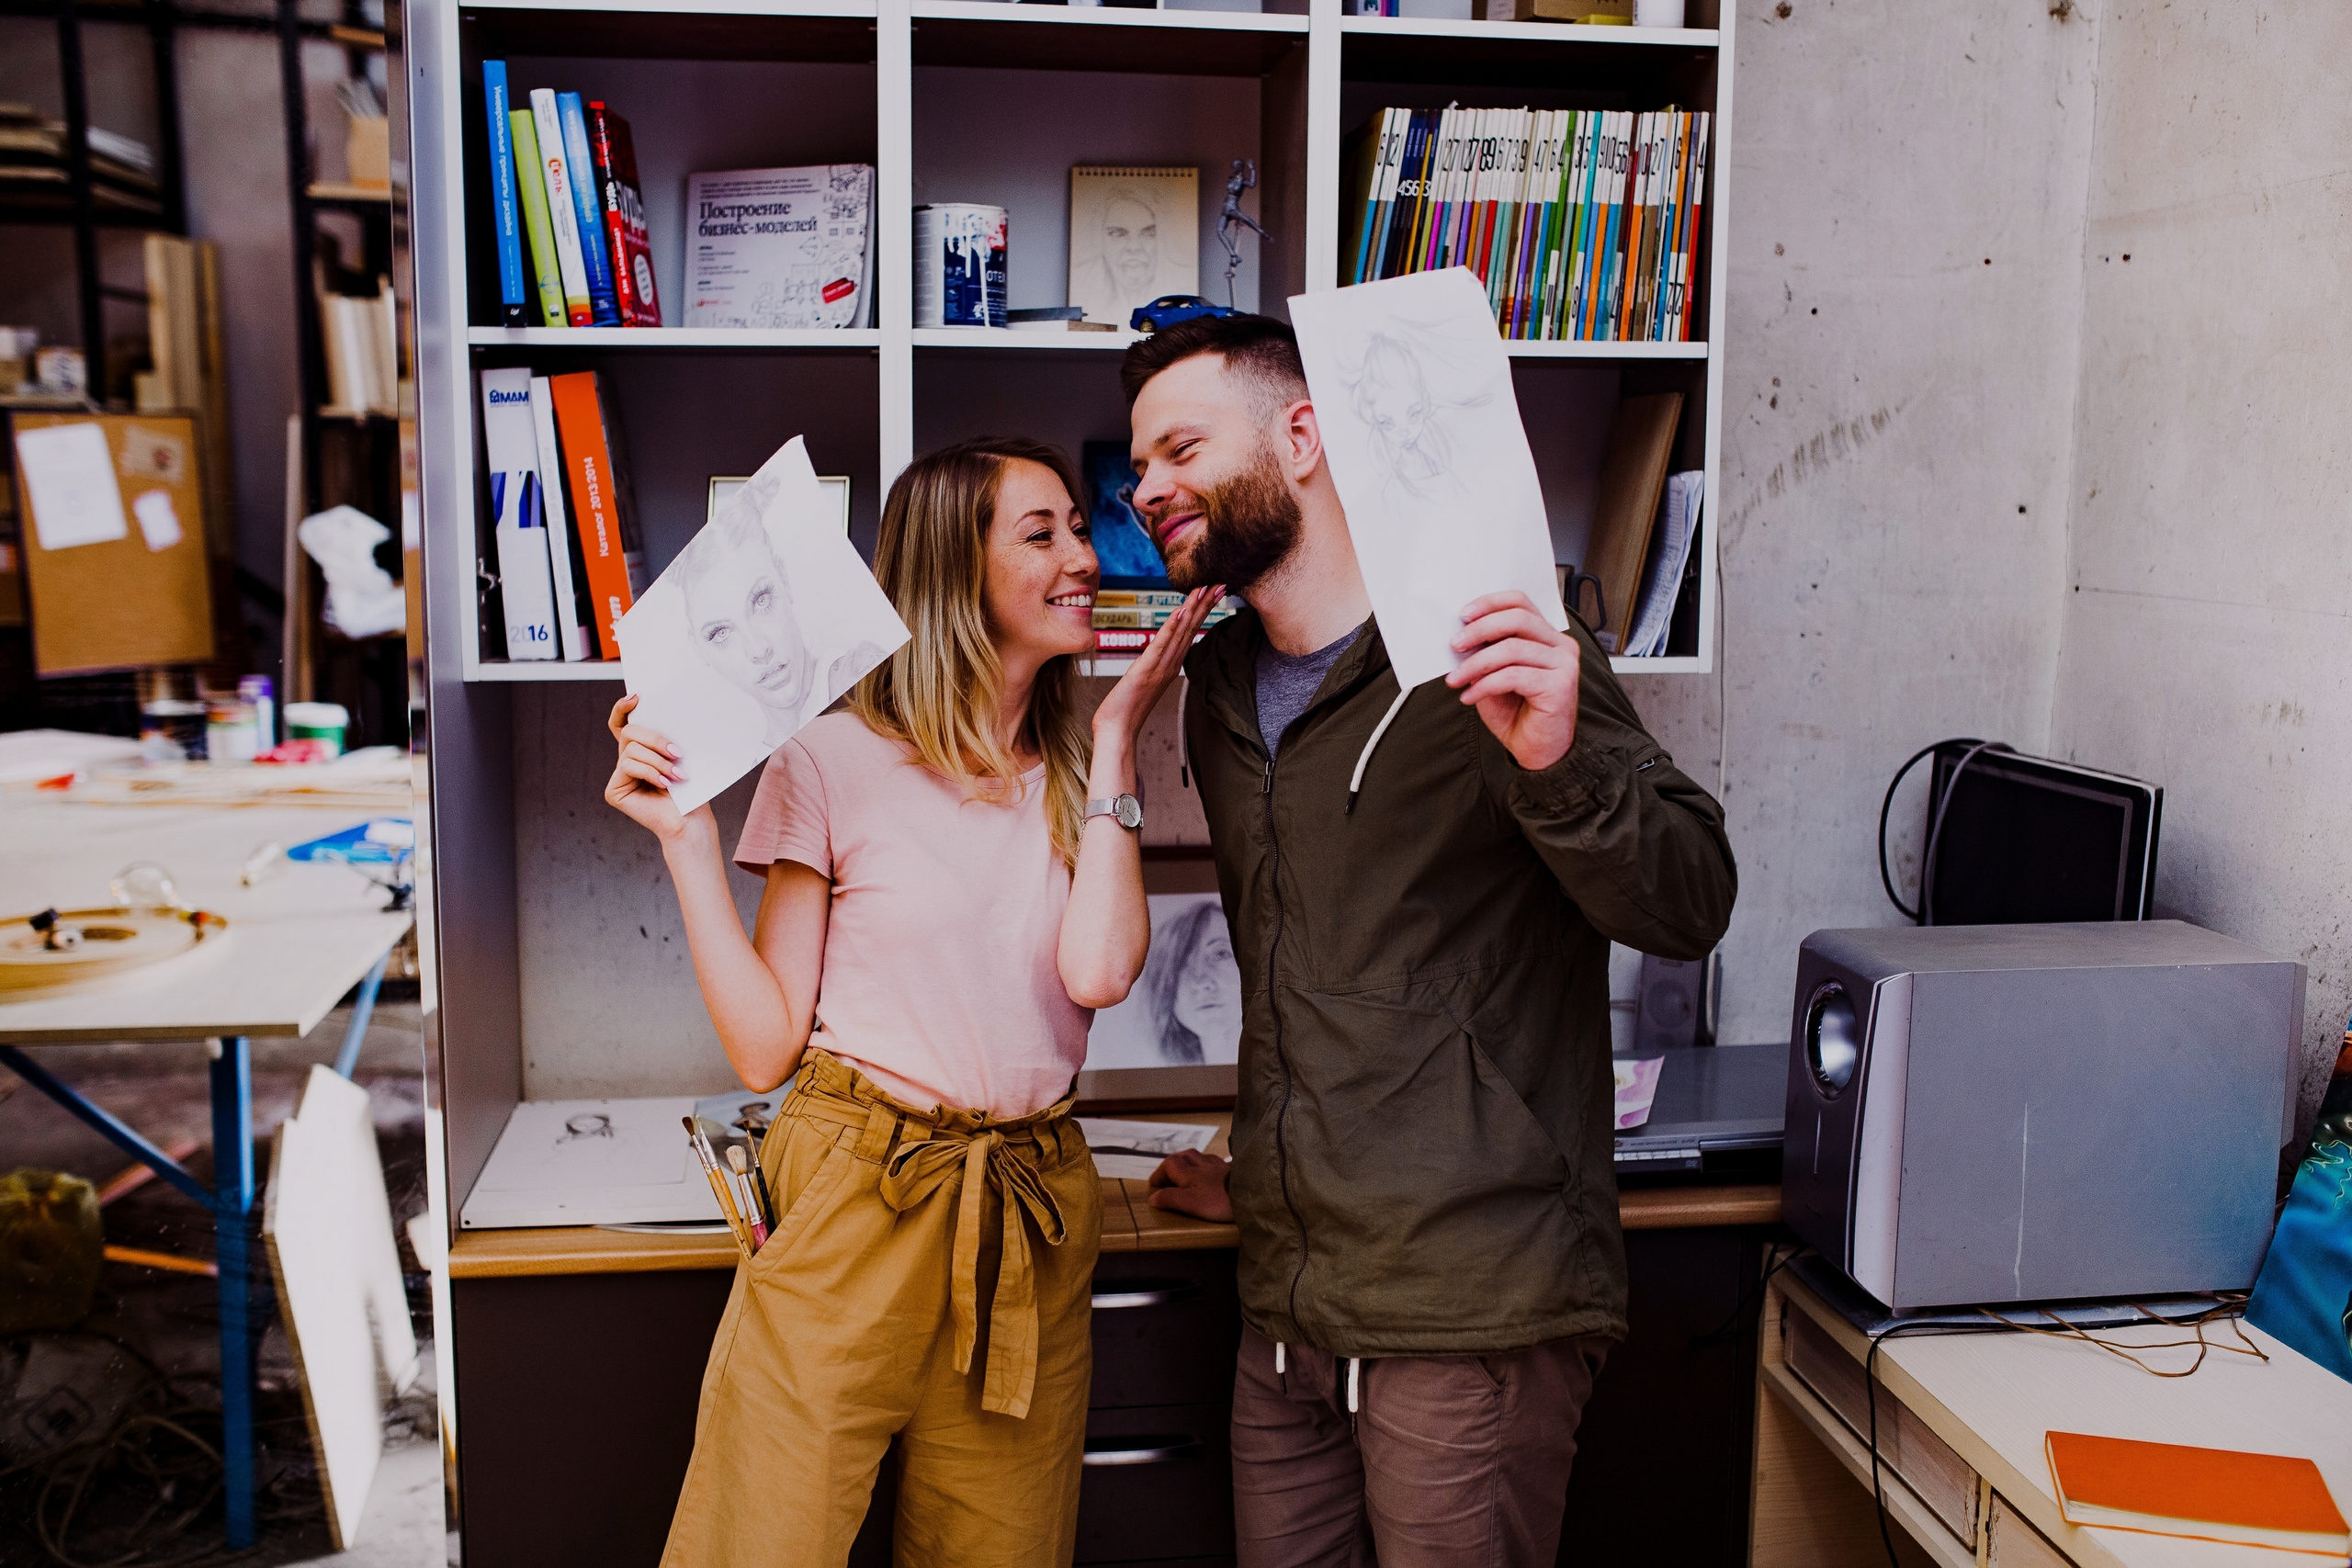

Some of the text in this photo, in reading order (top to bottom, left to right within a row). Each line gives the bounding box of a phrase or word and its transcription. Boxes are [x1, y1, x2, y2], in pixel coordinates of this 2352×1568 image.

[494, 85, 506, 152] Универсальные
[605, 181, 617, 211] БУДЬ
[700, 201, 791, 221] Построение
[698, 216, 818, 237] бизнес-моделей
[594, 512, 609, 557] Каталог
[1099, 633, 1147, 648] КОНОР
